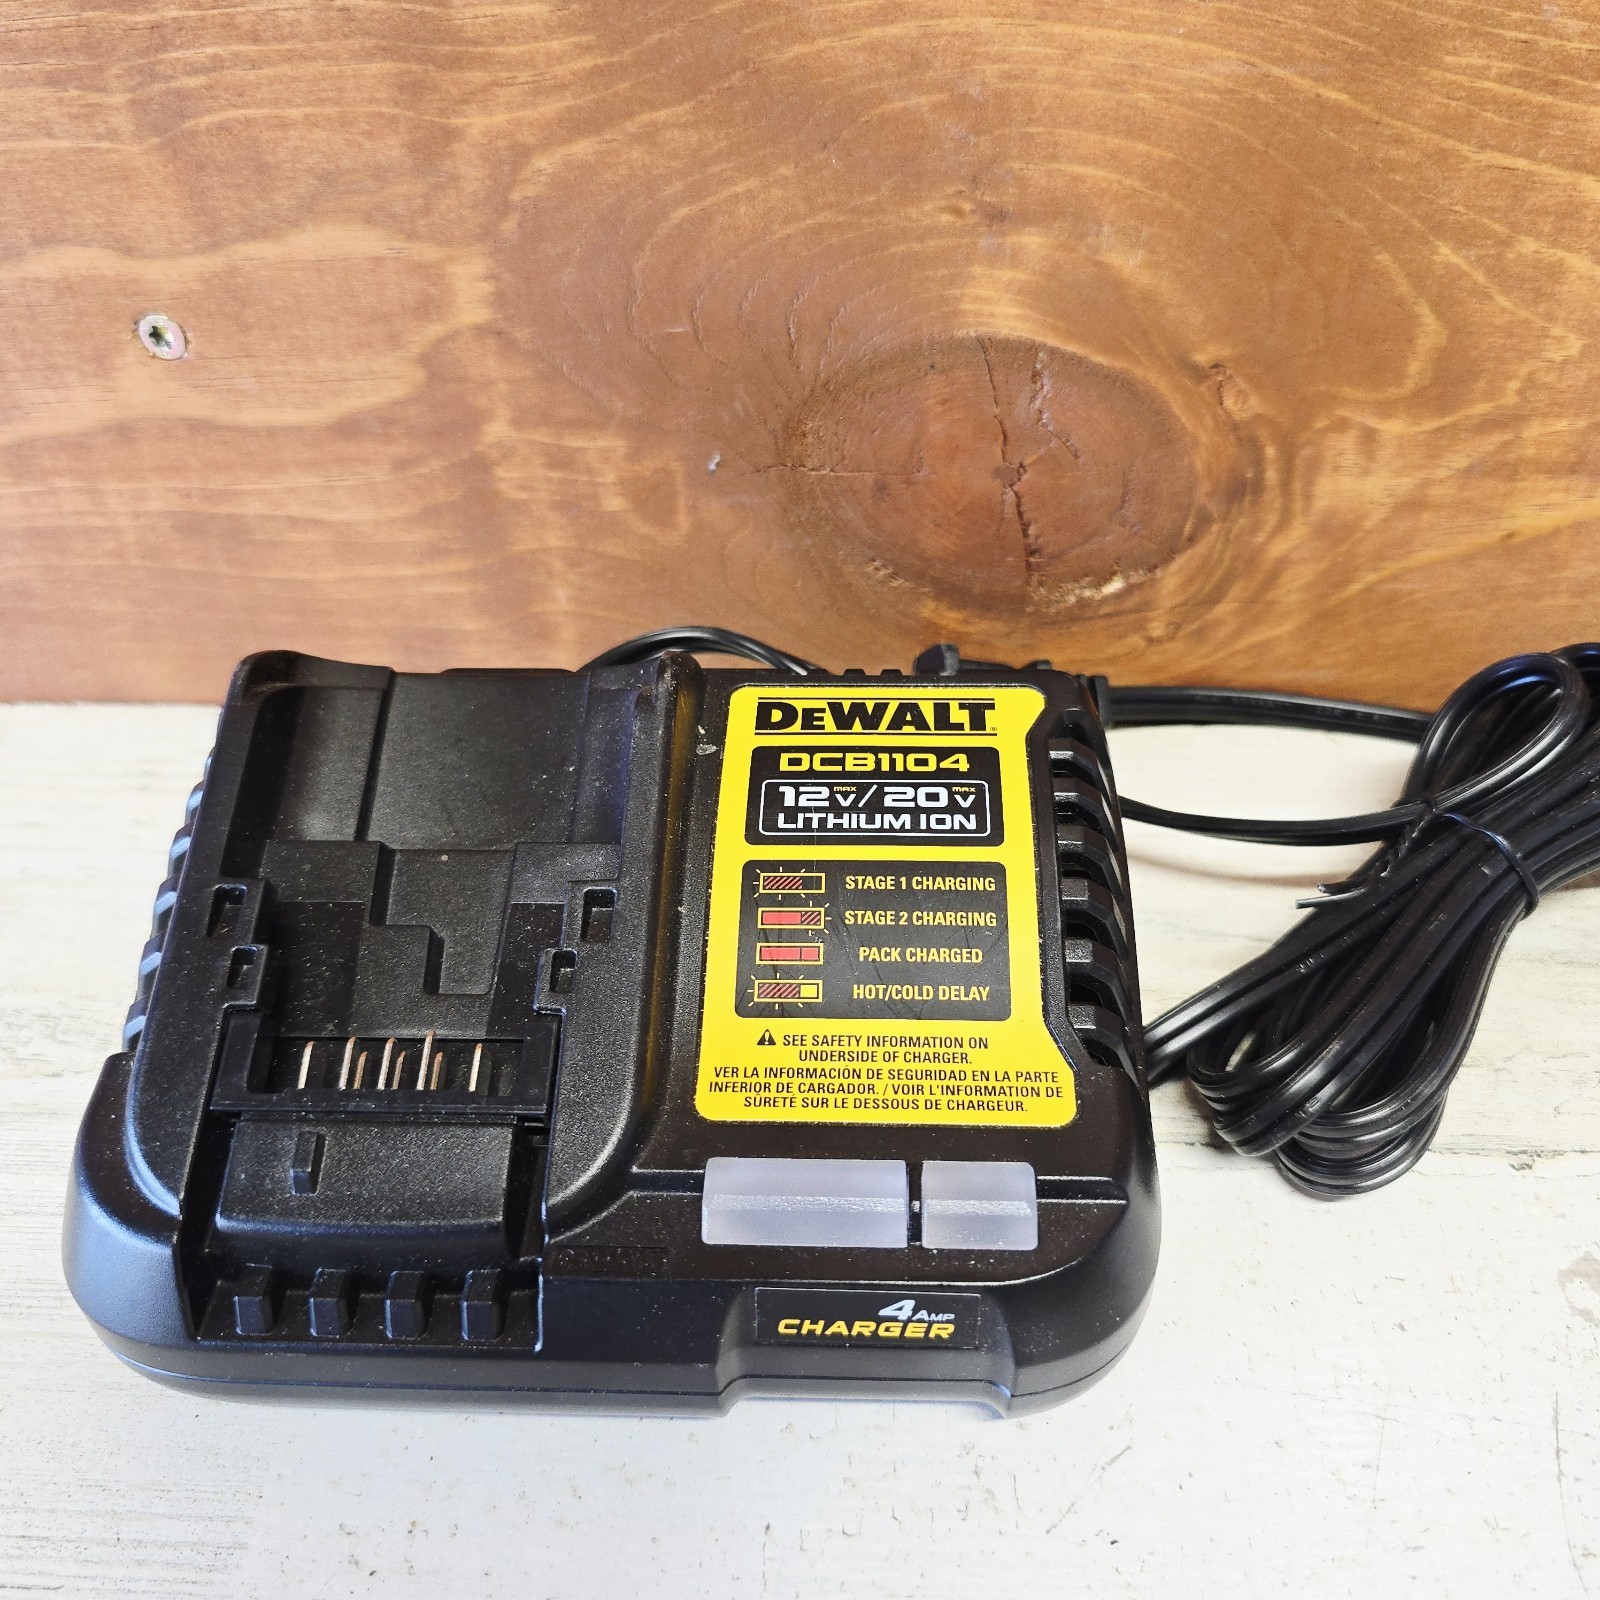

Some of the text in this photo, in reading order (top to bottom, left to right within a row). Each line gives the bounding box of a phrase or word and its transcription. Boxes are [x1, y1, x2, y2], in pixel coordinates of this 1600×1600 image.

[779, 753, 970, 772] DCB1104
[778, 813, 977, 830] LITHIUM ION
[845, 876, 996, 892] STAGE 1 CHARGING
[844, 911, 997, 927] STAGE 2 CHARGING
[859, 947, 983, 964] PACK CHARGED
[853, 984, 990, 1001] HOT/COLD DELAY
[783, 1034, 989, 1049] SEE SAFETY INFORMATION ON
[799, 1050, 973, 1064] UNDERSIDE OF CHARGER.
[714, 1065, 1059, 1083] VER LA INFORMACIÓN DE SEGURIDAD EN LA PARTE
[709, 1081, 772, 1093] INFERIOR
[776, 1082, 794, 1093] DE
[798, 1082, 879, 1095] CARGADOR.
[891, 1084, 925, 1096] VOIR
[929, 1085, 1041, 1097] L'INFORMATION
[1045, 1086, 1064, 1098] DE
[744, 1093, 1028, 1112] SÛRETÉ SUR LE DESSOUS DE CHARGEUR.
[777, 1319, 956, 1339] CHARGER
